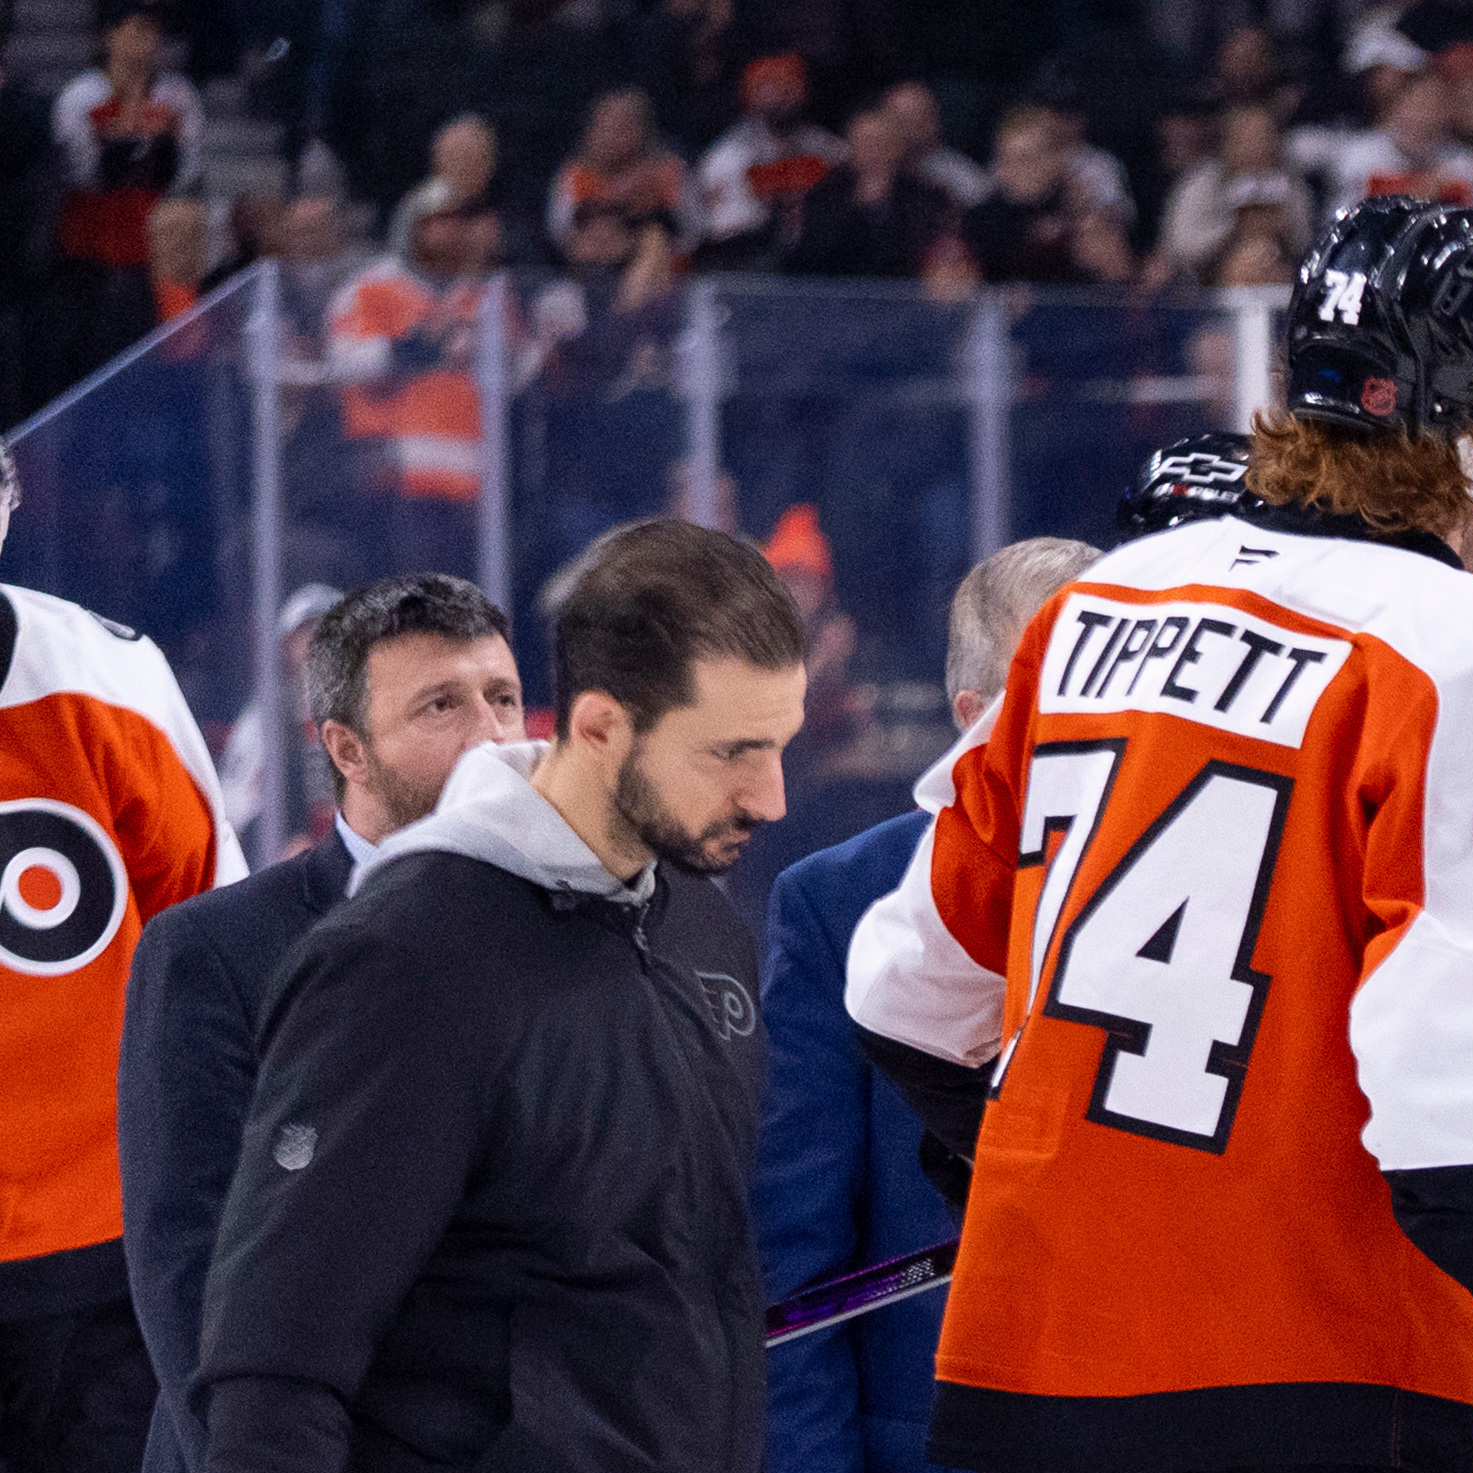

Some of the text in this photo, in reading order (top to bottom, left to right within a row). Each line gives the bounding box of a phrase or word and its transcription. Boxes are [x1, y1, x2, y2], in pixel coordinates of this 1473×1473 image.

[1319, 269, 1367, 326] 74
[1056, 609, 1329, 726] TIPPETT
[986, 736, 1297, 1156] 74
